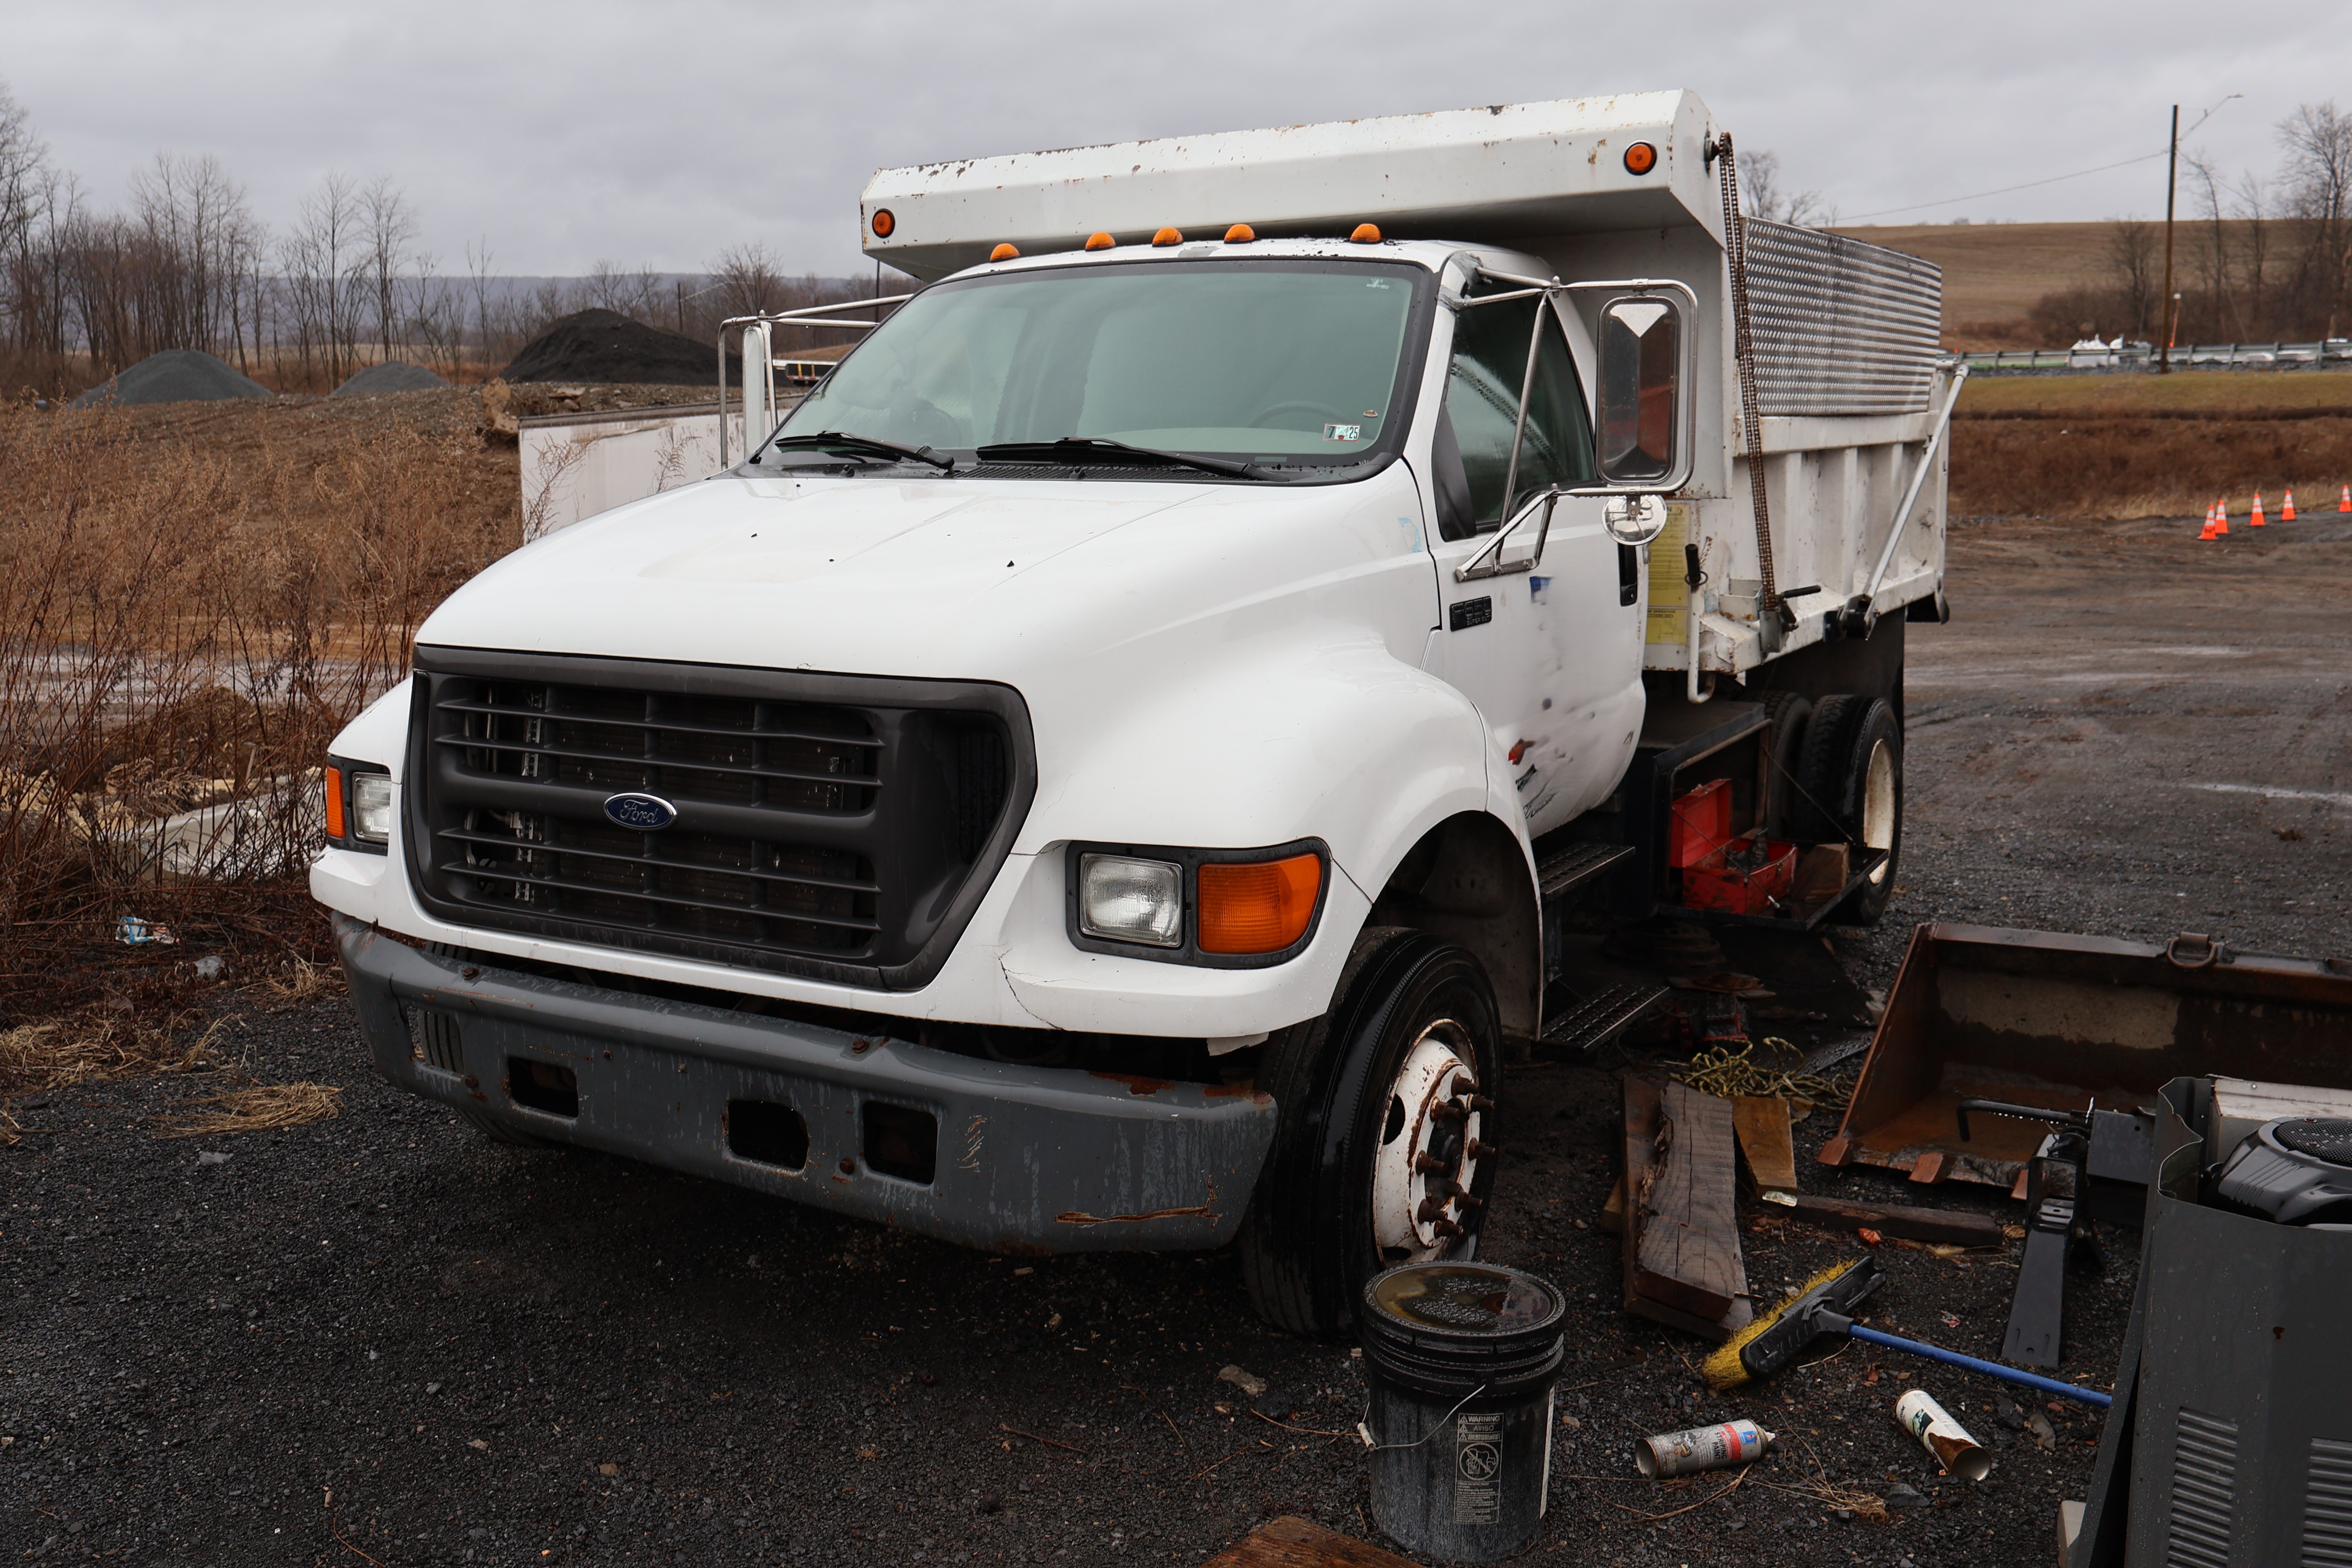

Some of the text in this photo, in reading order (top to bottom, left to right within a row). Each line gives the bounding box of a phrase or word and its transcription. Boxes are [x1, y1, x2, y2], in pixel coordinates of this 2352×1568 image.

[1329, 426, 1336, 439] 7
[1349, 426, 1358, 439] 25
[1466, 617, 1481, 626] SUPER
[620, 799, 659, 823] Ford
[1712, 1442, 1720, 1459] PAINT
[1715, 1432, 1727, 1459] STRIPING
